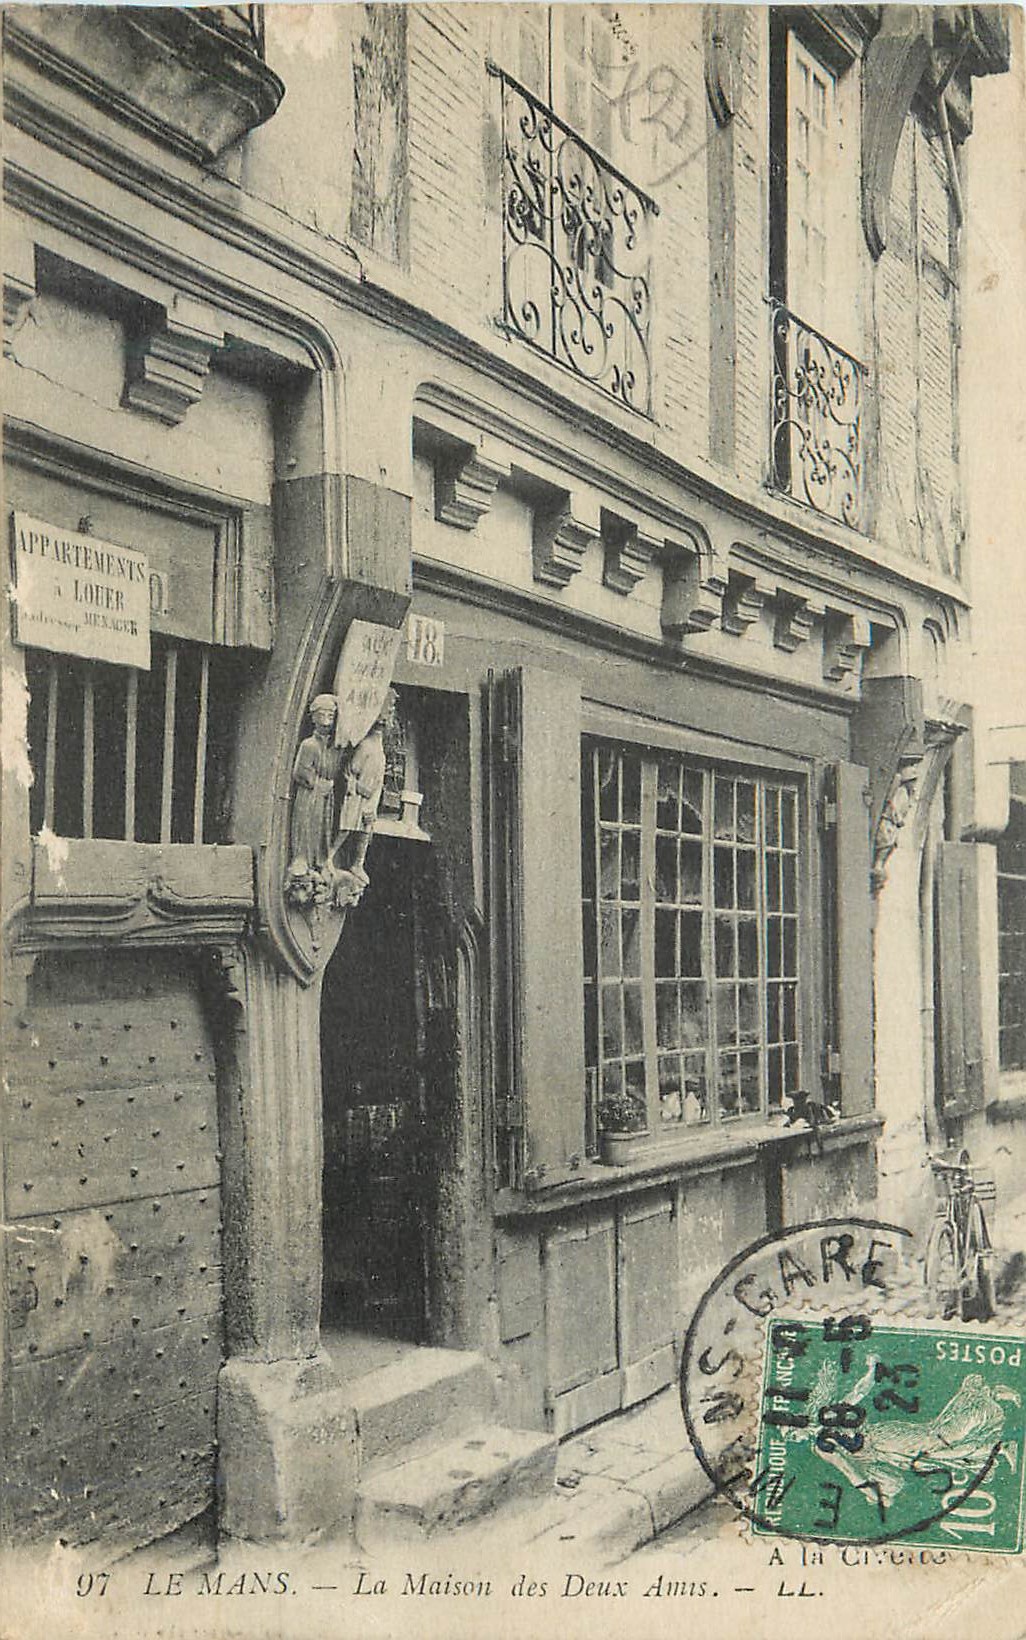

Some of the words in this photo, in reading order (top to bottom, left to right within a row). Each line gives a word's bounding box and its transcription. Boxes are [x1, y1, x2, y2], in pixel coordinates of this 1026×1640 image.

[20, 529, 145, 583] APPARTEMENTS
[74, 579, 124, 611] LOUER
[936, 1340, 1022, 1367] POSTES
